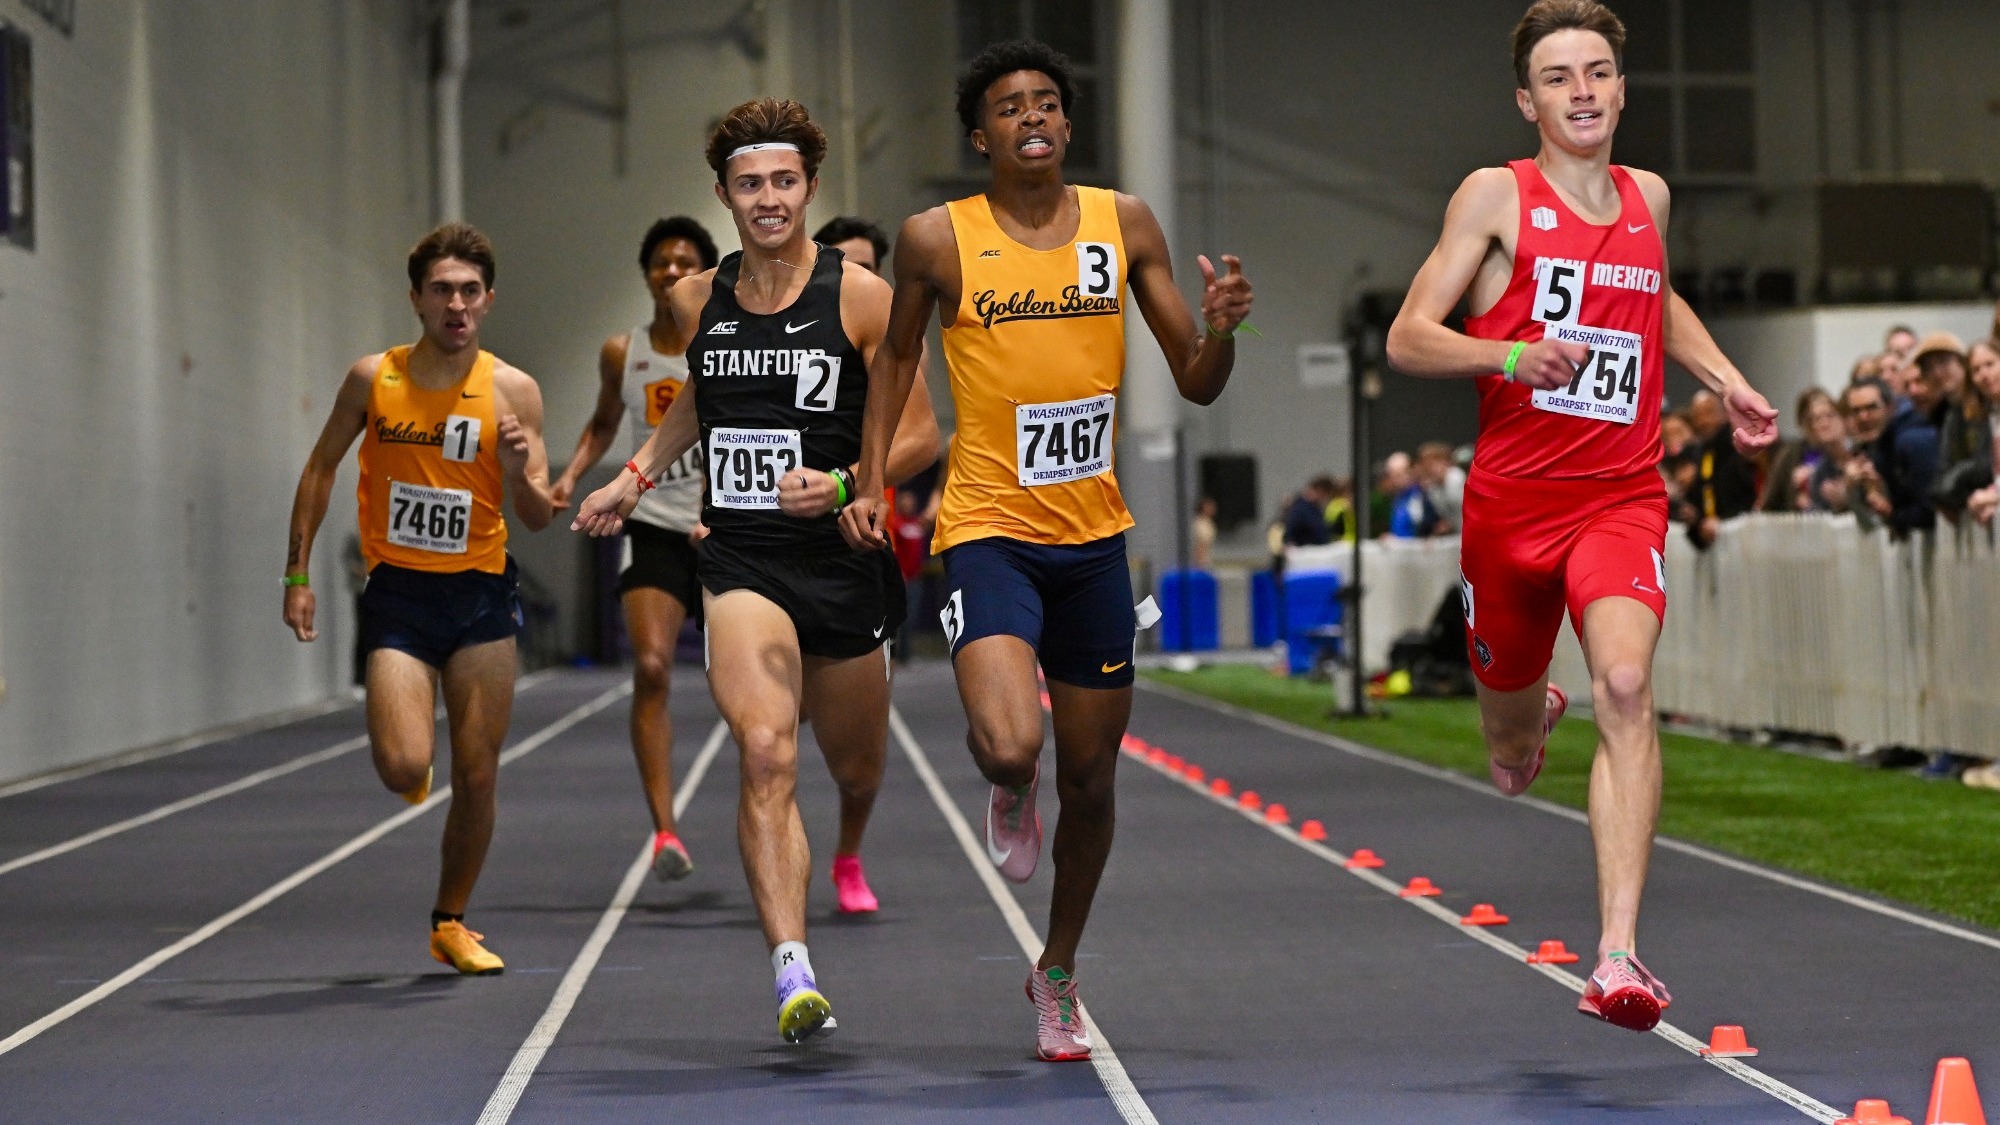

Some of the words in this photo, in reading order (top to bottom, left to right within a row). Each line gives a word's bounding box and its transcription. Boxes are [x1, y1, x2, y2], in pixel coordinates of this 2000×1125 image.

[1086, 245, 1110, 294] 3
[1591, 262, 1660, 295] MEXICO
[1543, 266, 1575, 321] 5
[973, 289, 1057, 329] Golden
[707, 322, 739, 334] ACC
[1558, 328, 1636, 349] WASHINGTON
[703, 349, 826, 377] STANFOR
[1567, 350, 1637, 404] 754
[804, 358, 830, 408] 2
[1028, 400, 1107, 419] WASHINGTON
[1548, 396, 1592, 411] DEMPSEY
[1594, 403, 1627, 416] INDOOR
[375, 416, 428, 443] Golden
[454, 420, 469, 460] 1
[717, 433, 789, 444] WASHINGTON
[1023, 412, 1109, 468] 7467
[1033, 467, 1073, 480] DEMPSEY
[1076, 461, 1103, 475] INDOOR
[400, 487, 463, 501] WASHINGTON
[724, 495, 758, 504] DEMPSEY
[394, 497, 466, 540] 7466
[946, 599, 958, 648] 3
